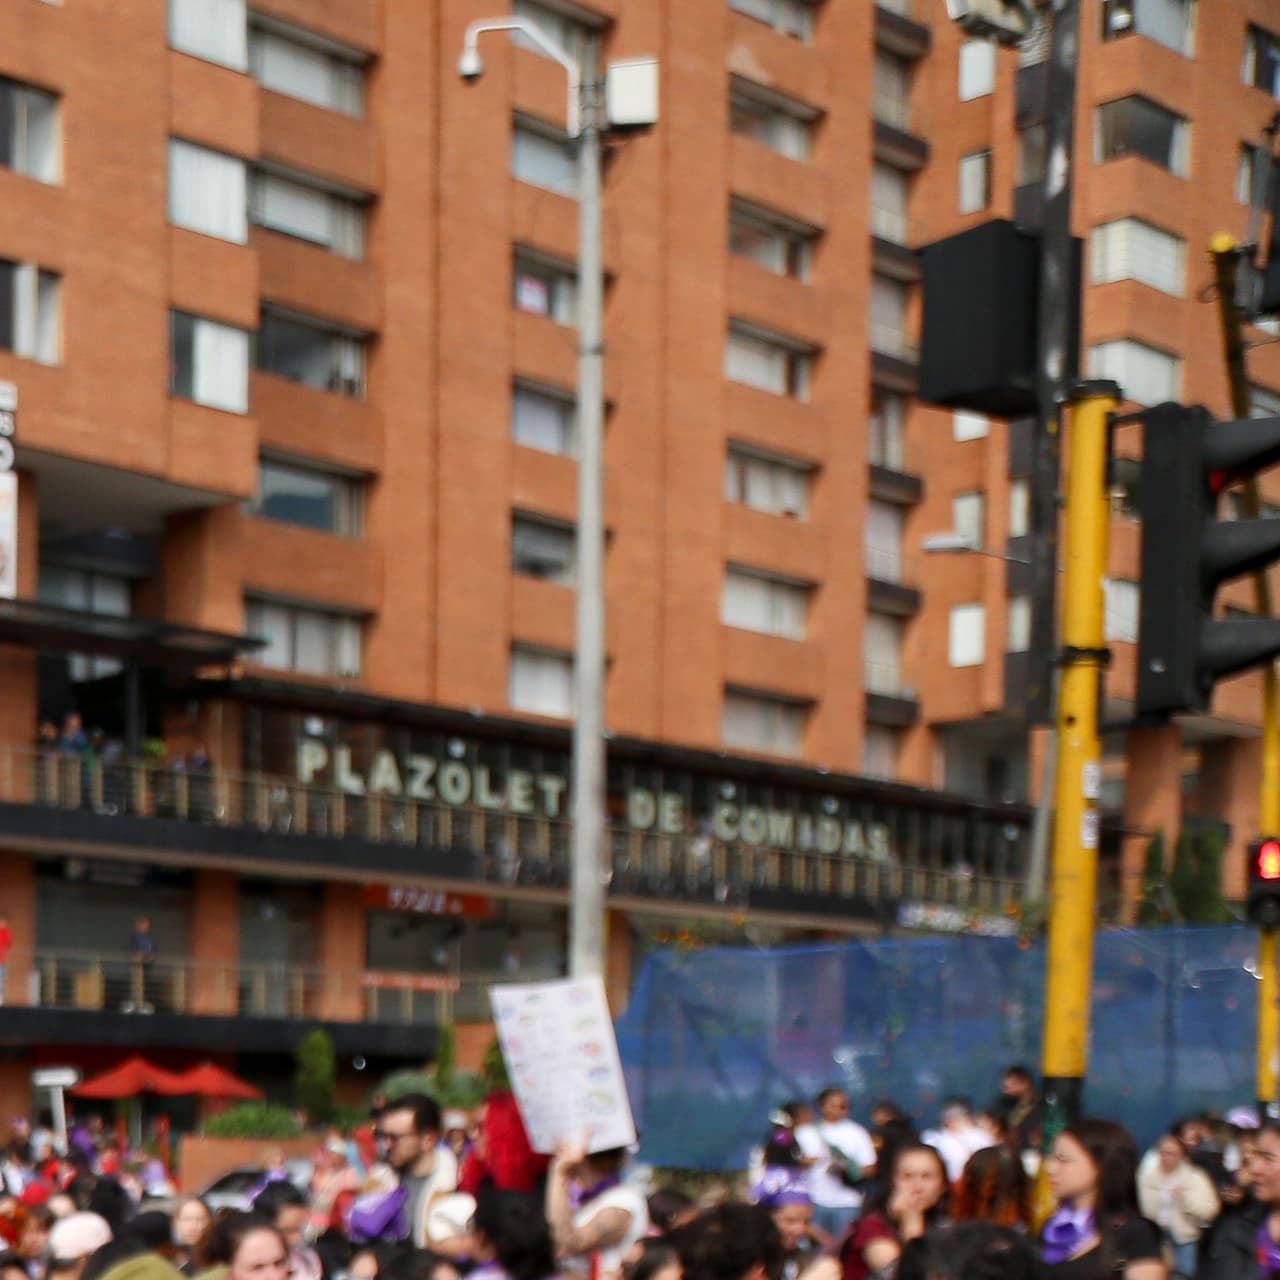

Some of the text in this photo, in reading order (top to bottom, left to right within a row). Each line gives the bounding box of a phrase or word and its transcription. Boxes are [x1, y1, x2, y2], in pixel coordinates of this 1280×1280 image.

[297, 738, 890, 862] PLAZOLET DE COMIDAS
